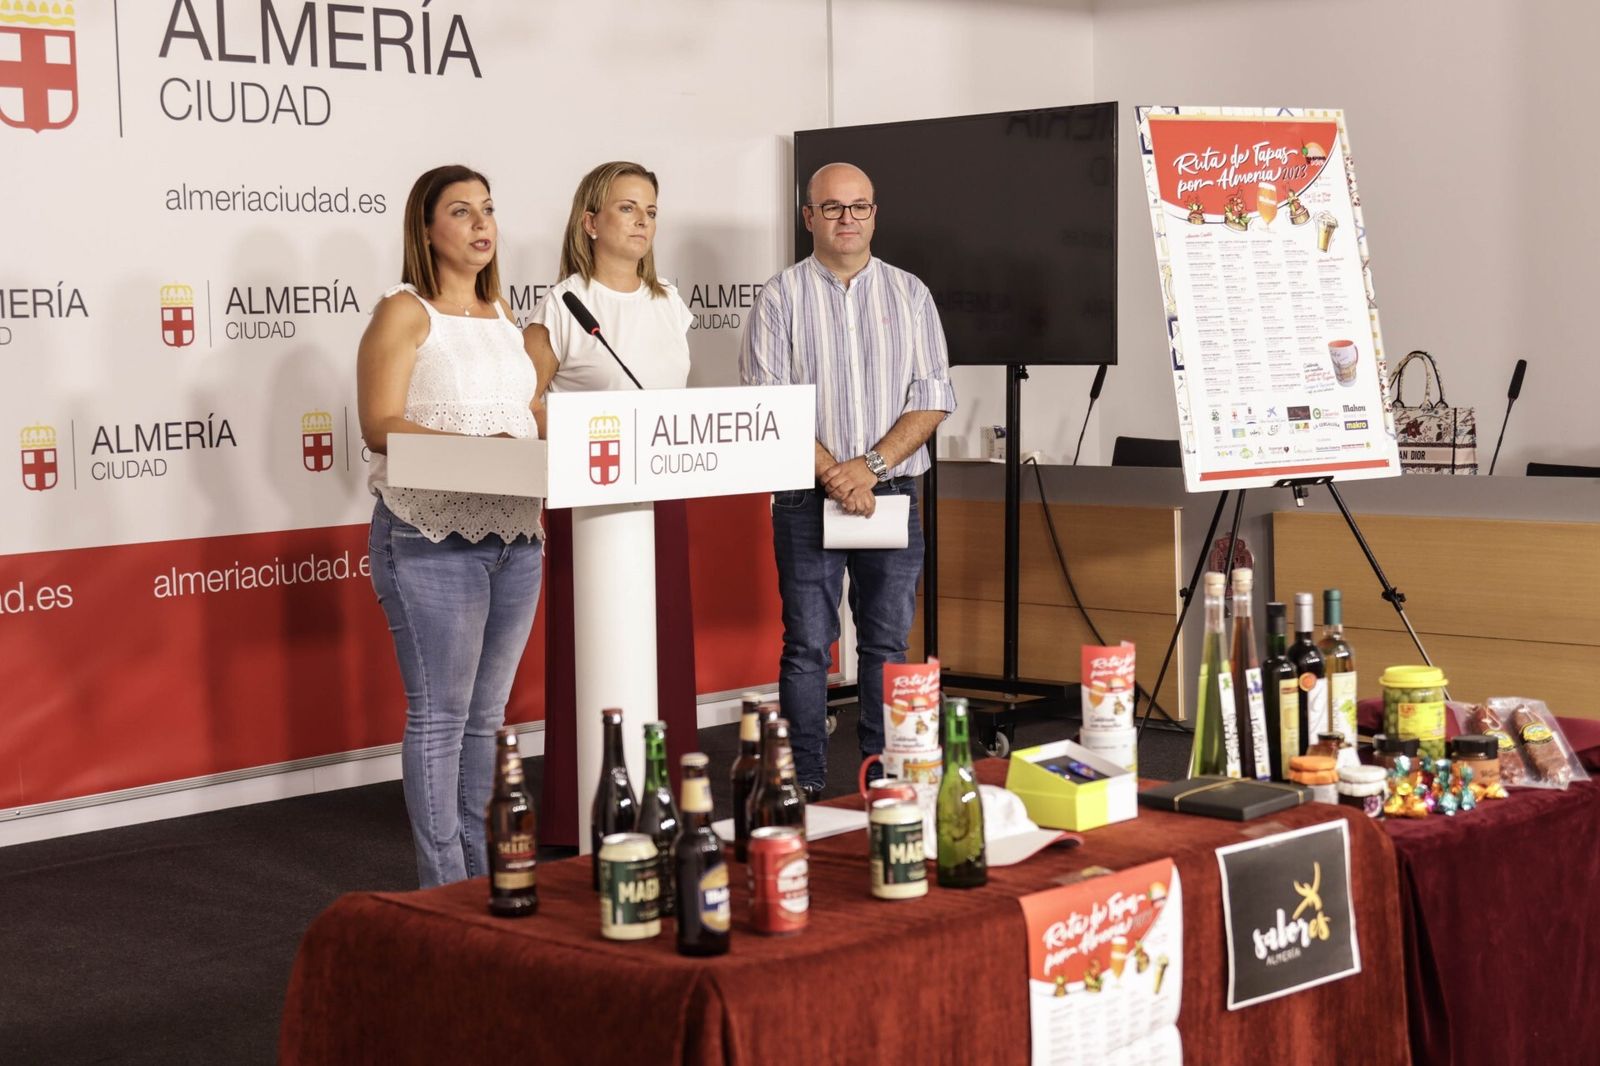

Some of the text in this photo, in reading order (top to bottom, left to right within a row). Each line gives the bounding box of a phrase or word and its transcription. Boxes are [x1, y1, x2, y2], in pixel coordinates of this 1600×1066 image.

[158, 0, 483, 79] ALMERÍA
[160, 77, 332, 127] CIUDAD
[1173, 141, 1298, 175] Ruta de Tapas
[1177, 163, 1307, 199] por Almería 2023
[166, 183, 387, 214] almeriaciudad.es
[226, 279, 360, 316] ALMERÍA
[226, 321, 296, 340] CIUDAD
[690, 314, 741, 330] CIUDAD
[1343, 404, 1366, 413] Mahou
[1346, 420, 1367, 429] makro
[91, 413, 238, 456] ALMERÍA
[651, 403, 780, 448] ALMERÍA
[91, 458, 168, 482] CIUDAD
[651, 452, 718, 476] CIUDAD
[1411, 450, 1426, 461] DIOR
[154, 550, 371, 600] almeriaciudad.e
